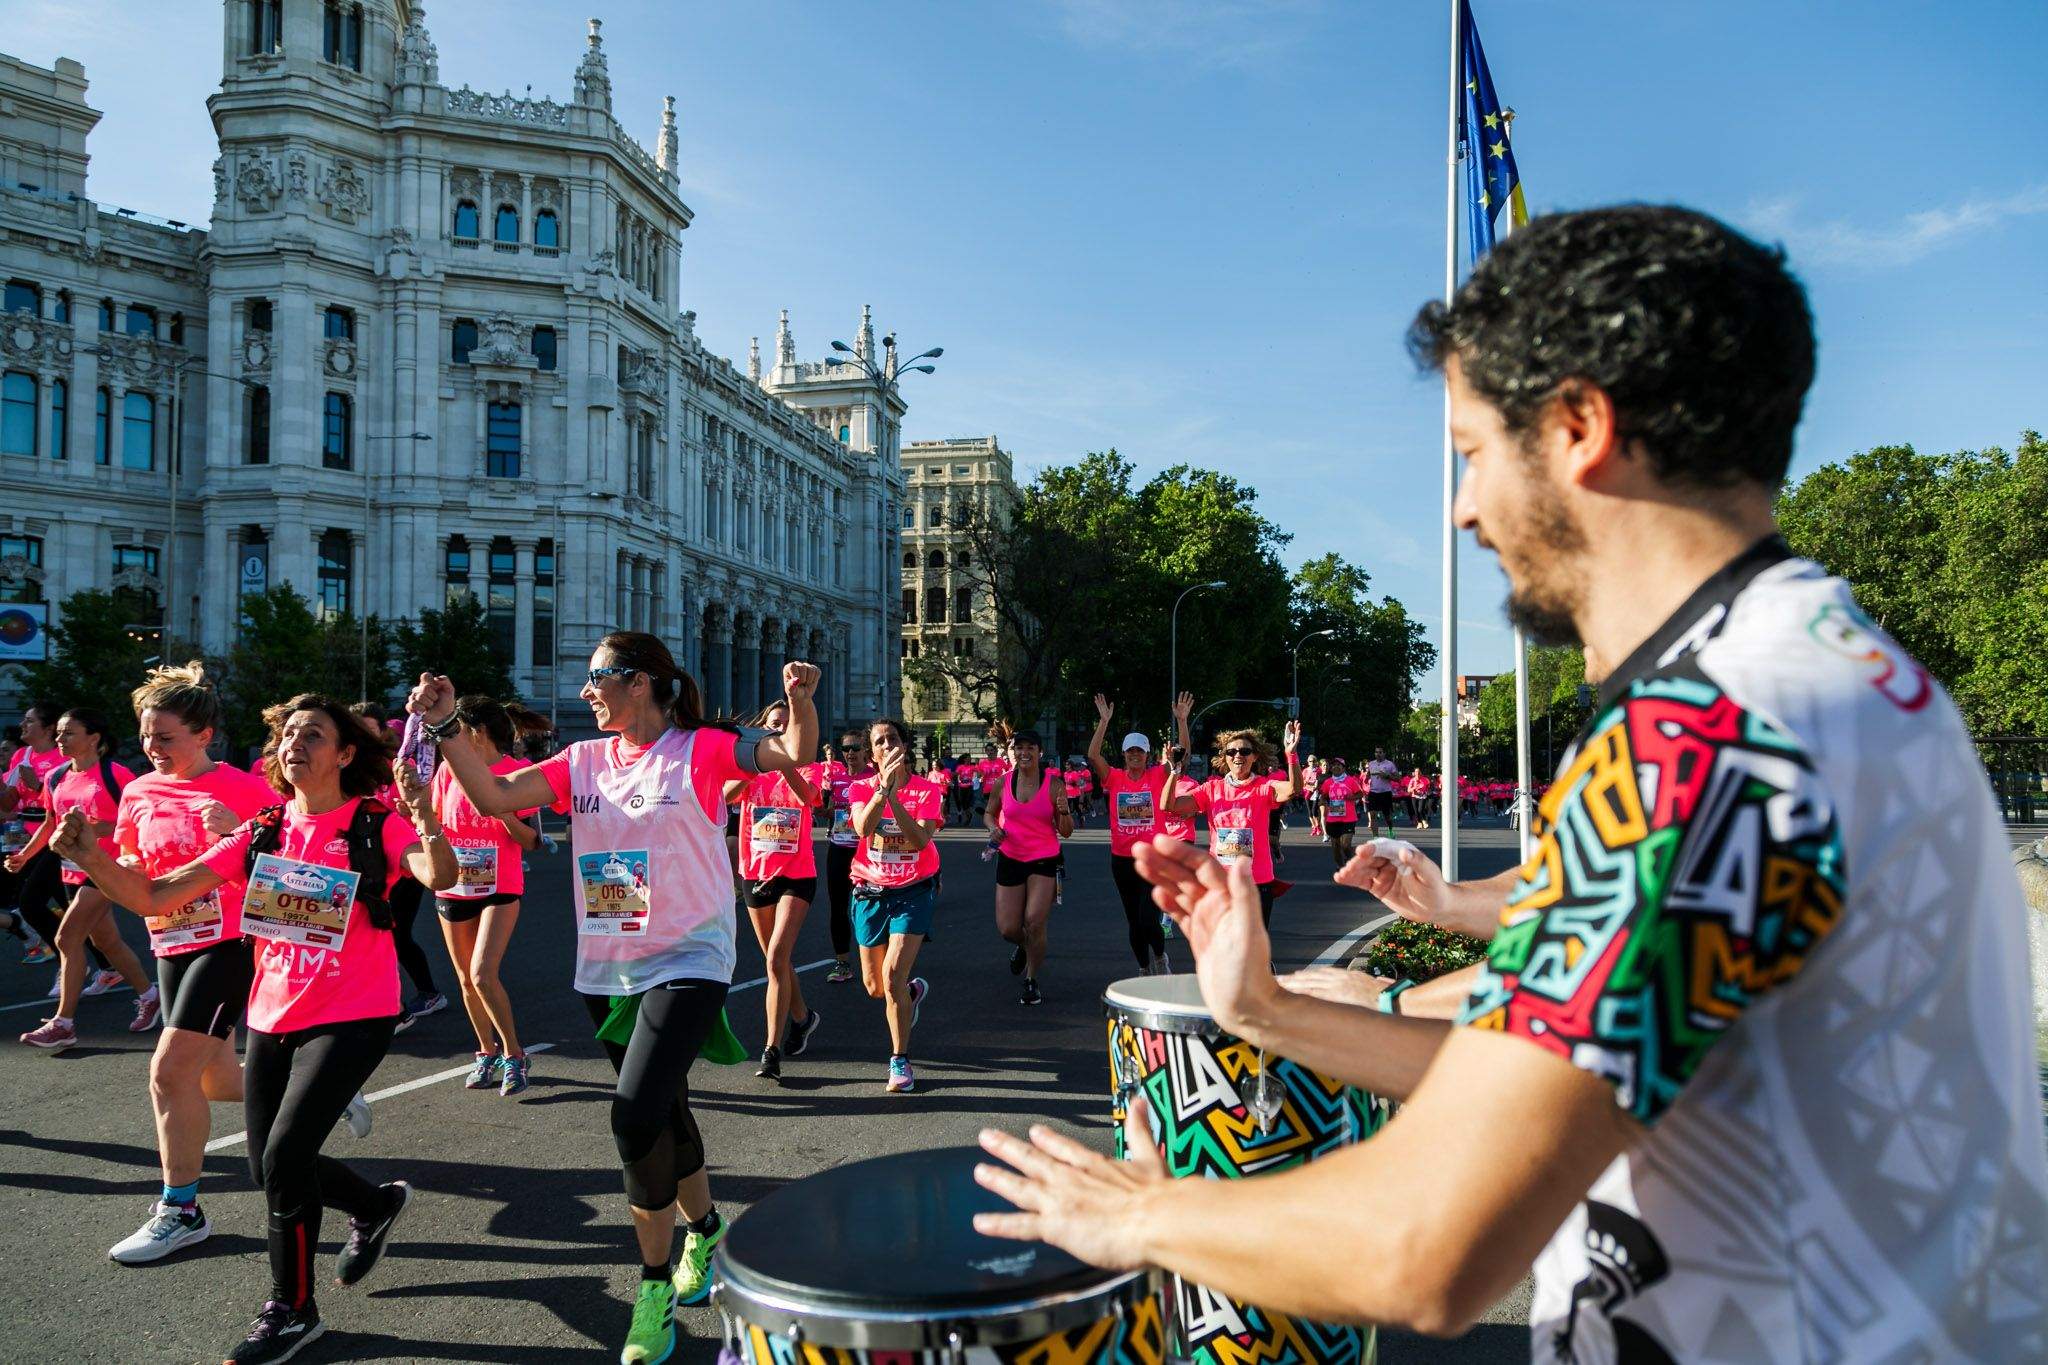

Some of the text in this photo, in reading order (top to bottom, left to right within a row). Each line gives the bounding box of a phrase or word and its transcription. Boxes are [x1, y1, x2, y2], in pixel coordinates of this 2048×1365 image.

[455, 838, 500, 848] DORSAL
[283, 874, 325, 890] ASTURIANA
[602, 885, 626, 899] 016
[277, 893, 321, 914] 016
[282, 911, 310, 922] 19974
[248, 923, 281, 936] OYSHO
